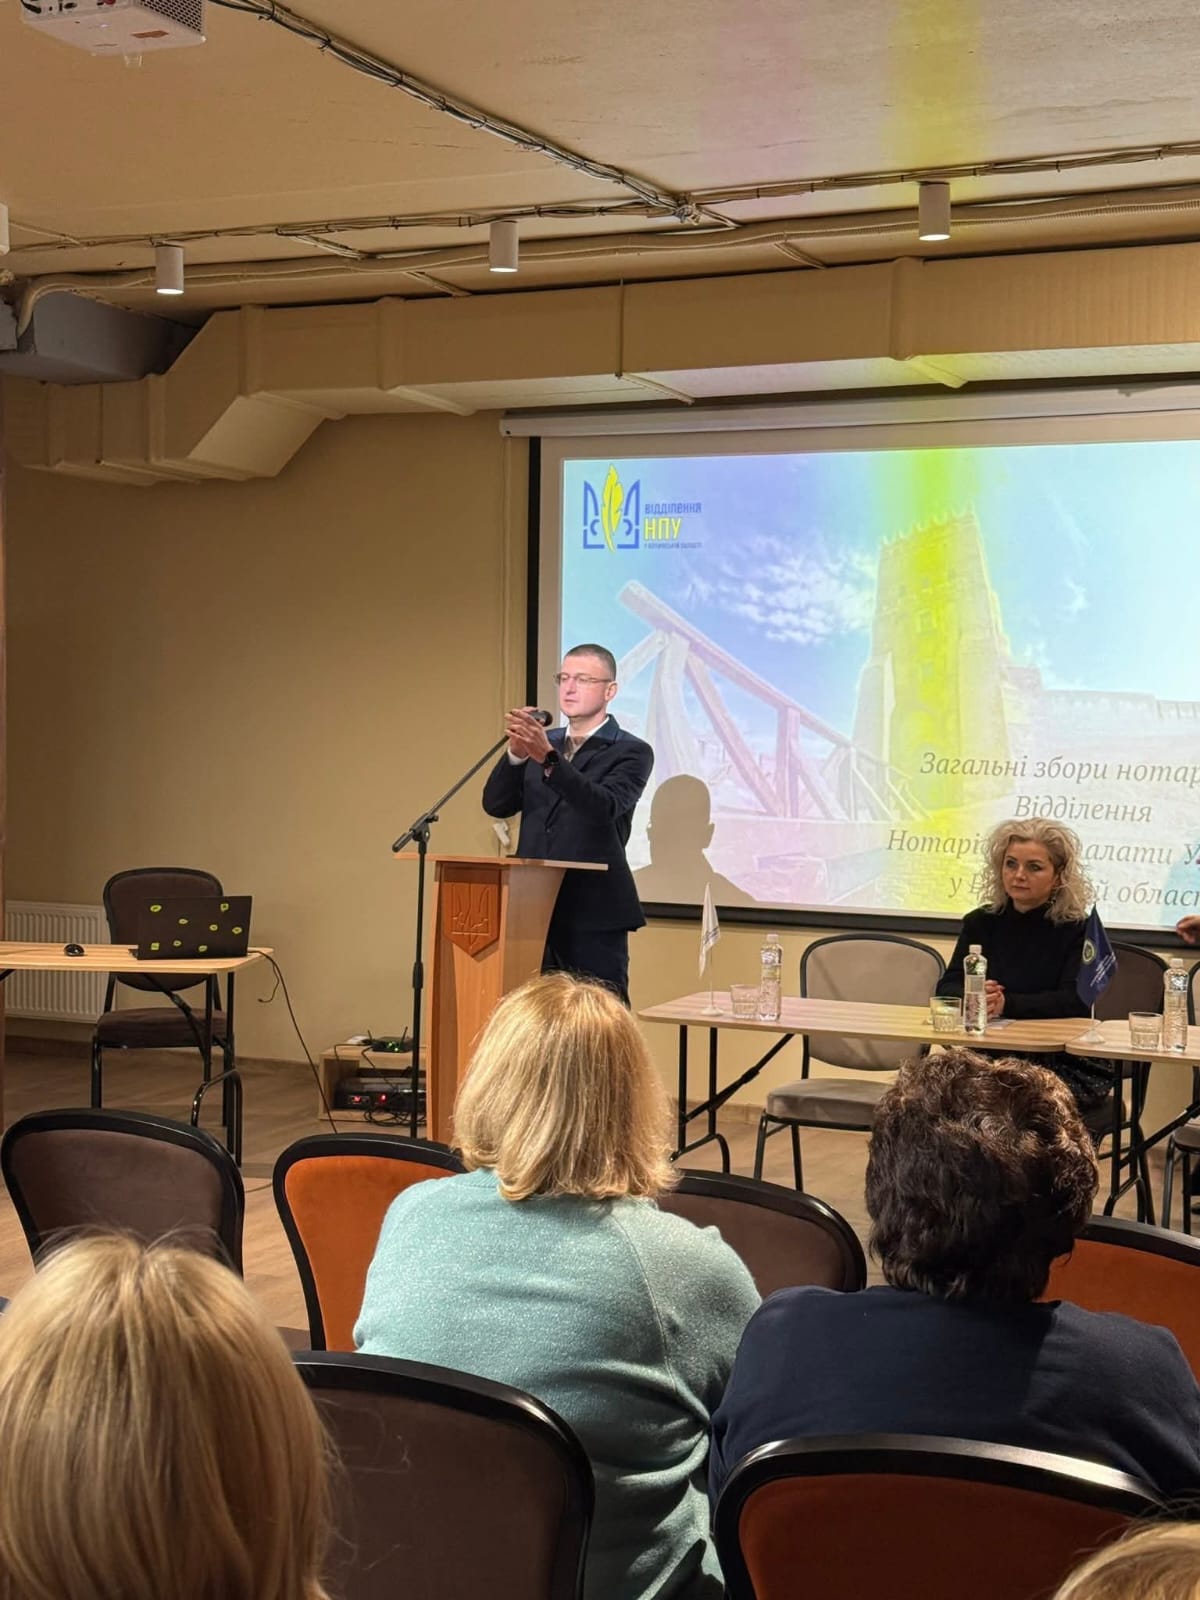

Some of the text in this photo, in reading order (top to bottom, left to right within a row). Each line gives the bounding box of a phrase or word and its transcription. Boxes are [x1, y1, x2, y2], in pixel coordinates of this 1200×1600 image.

[643, 516, 682, 541] НПУ
[920, 752, 1029, 777] Загальні
[1033, 755, 1108, 785] збори
[1014, 794, 1152, 823] Відділення
[1080, 843, 1172, 865] алати
